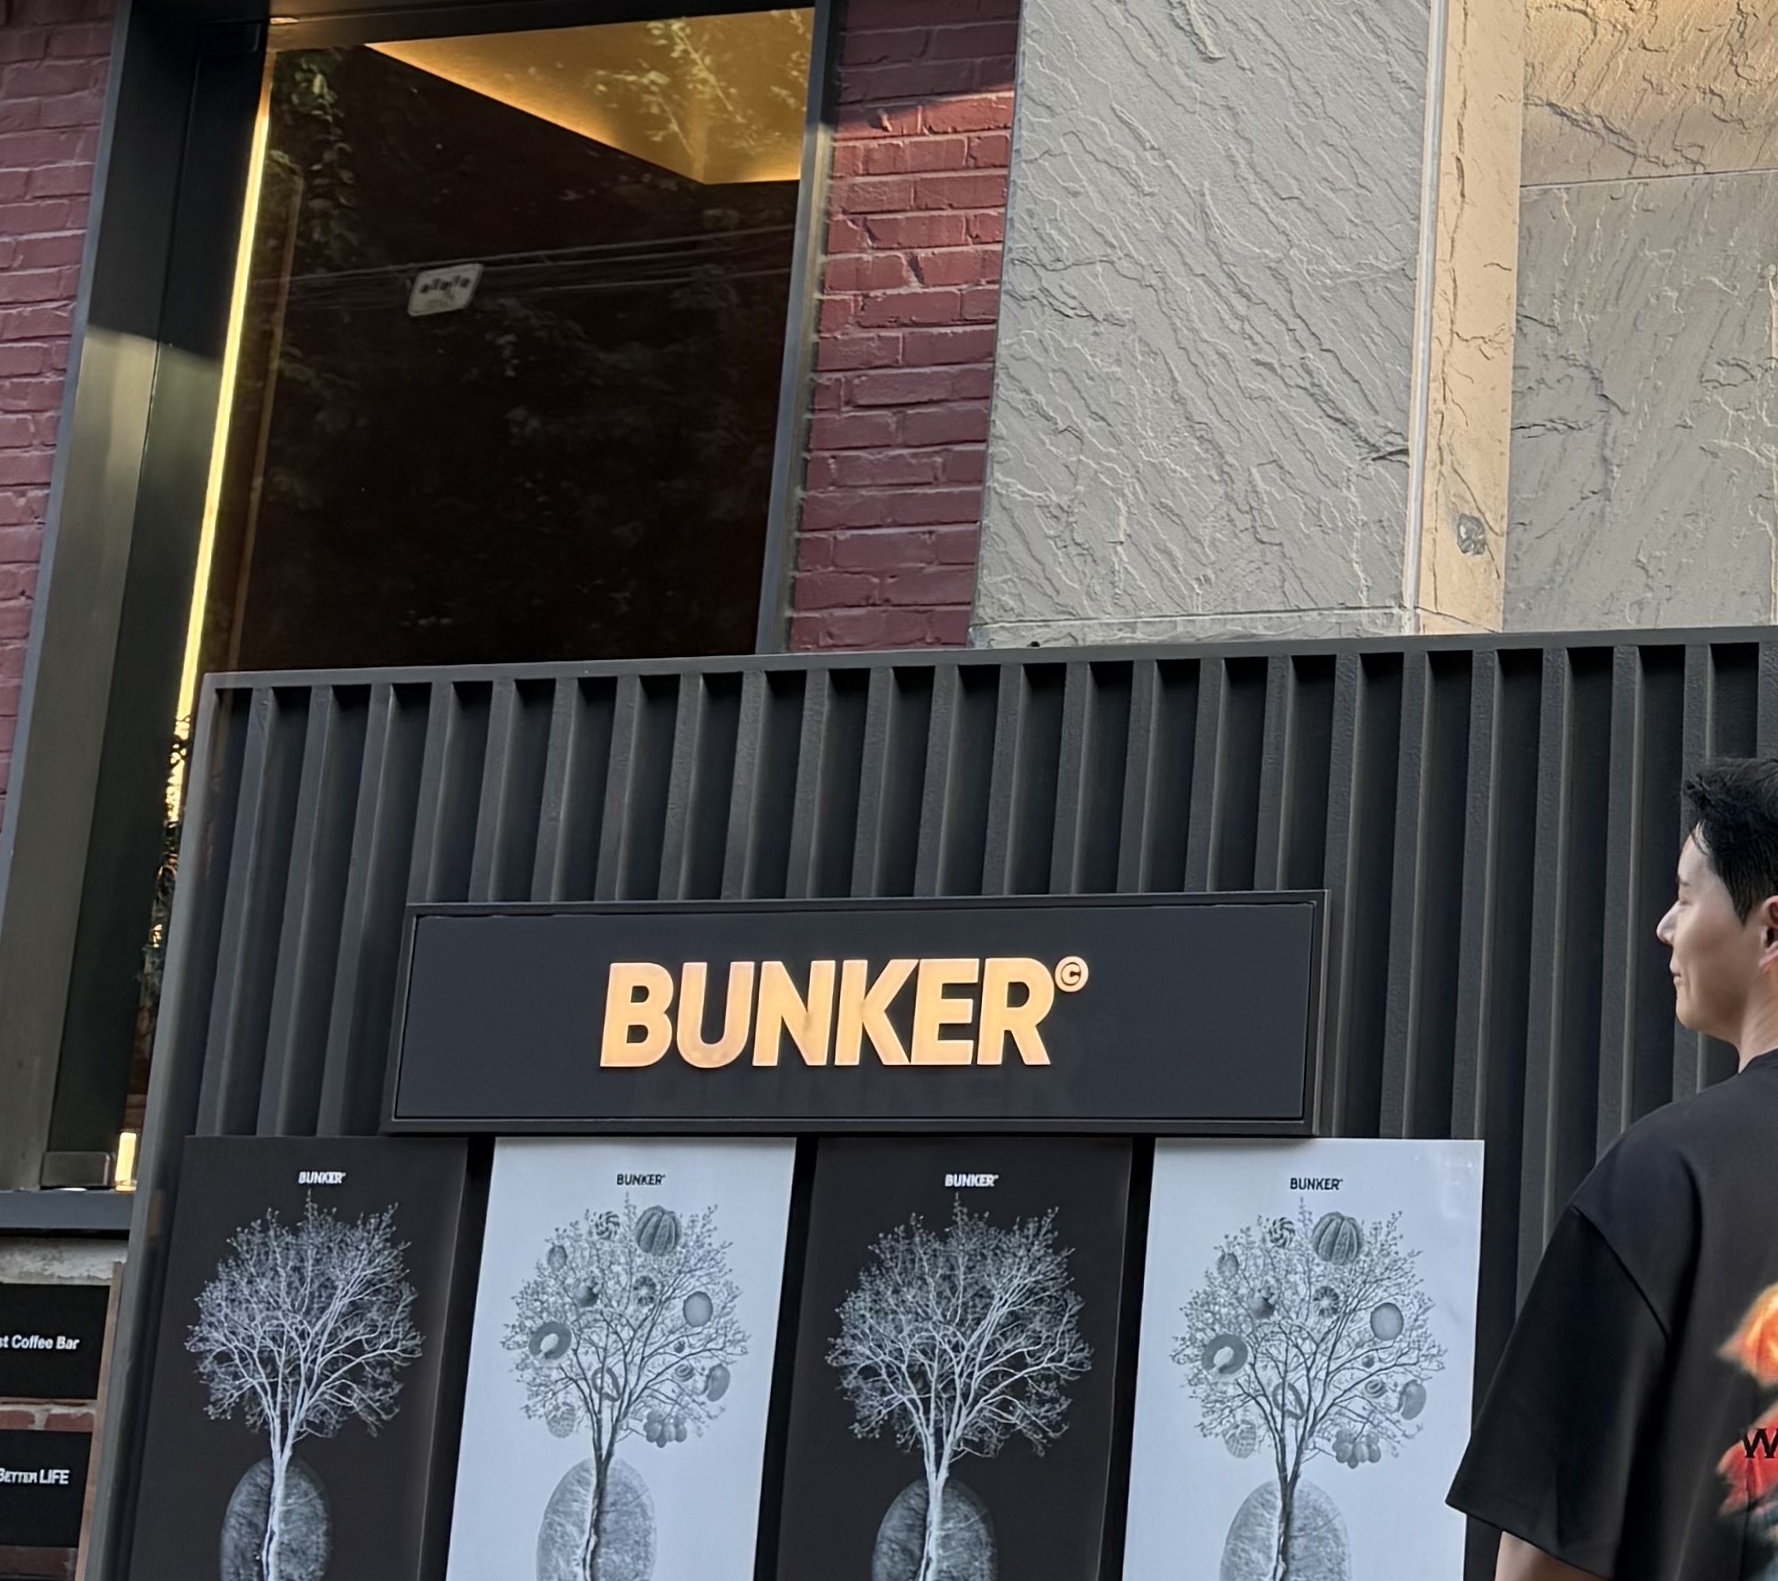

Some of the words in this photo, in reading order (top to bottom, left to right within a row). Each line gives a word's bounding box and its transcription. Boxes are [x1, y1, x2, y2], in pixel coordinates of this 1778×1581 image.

[11, 1334, 54, 1349] Coffee
[56, 1335, 80, 1350] Bar
[39, 1469, 70, 1484] LIFE
